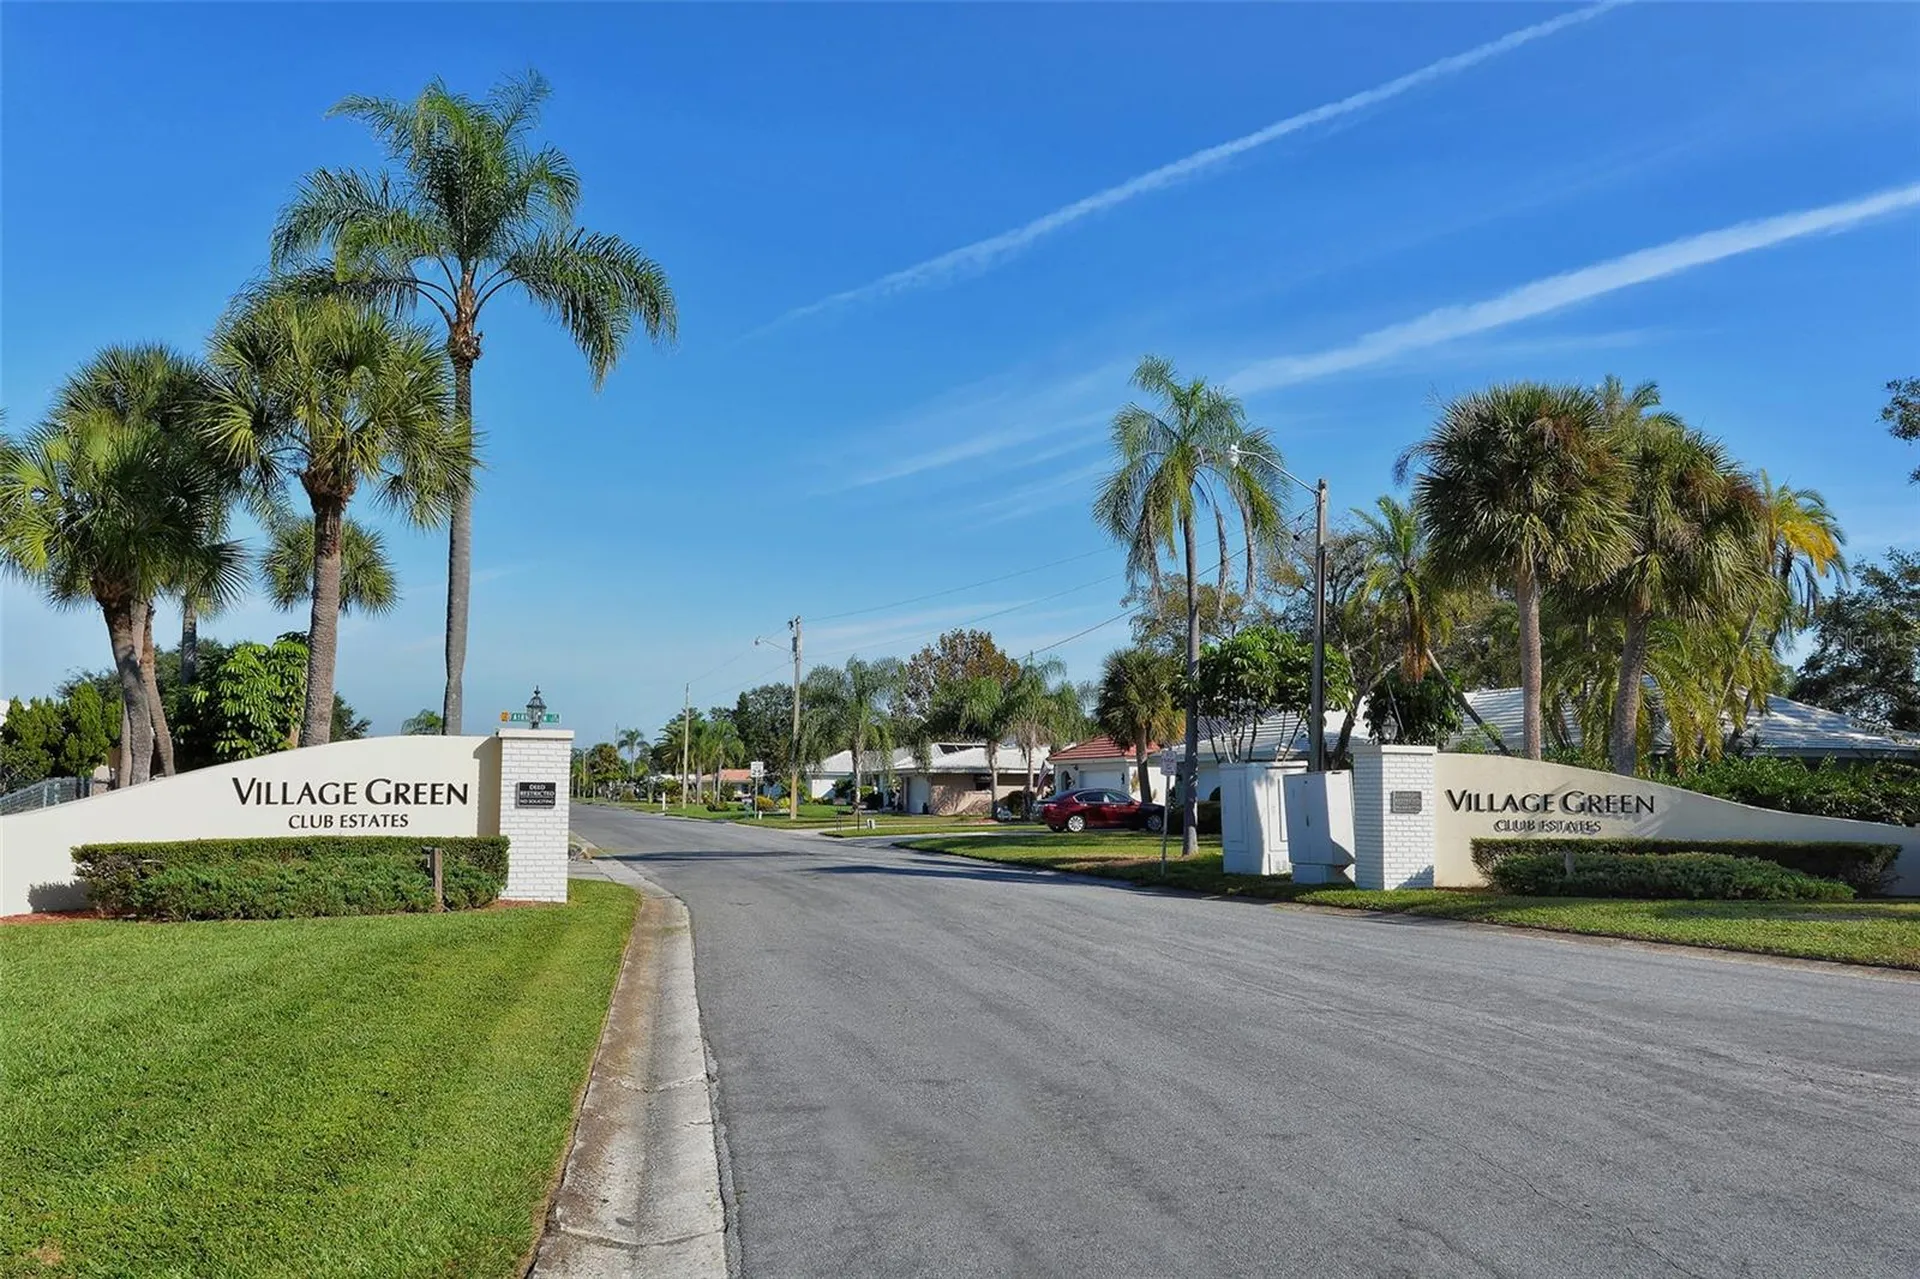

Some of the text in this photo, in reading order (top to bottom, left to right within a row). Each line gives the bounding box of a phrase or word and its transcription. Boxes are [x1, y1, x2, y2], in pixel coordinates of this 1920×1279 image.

[232, 777, 468, 805] VILLAGE GREEN
[1445, 789, 1555, 814] VILLAGE
[1561, 790, 1654, 815] GREEN
[288, 813, 409, 829] CLUB ESTATES
[1494, 819, 1601, 833] CLUB ESTATES
